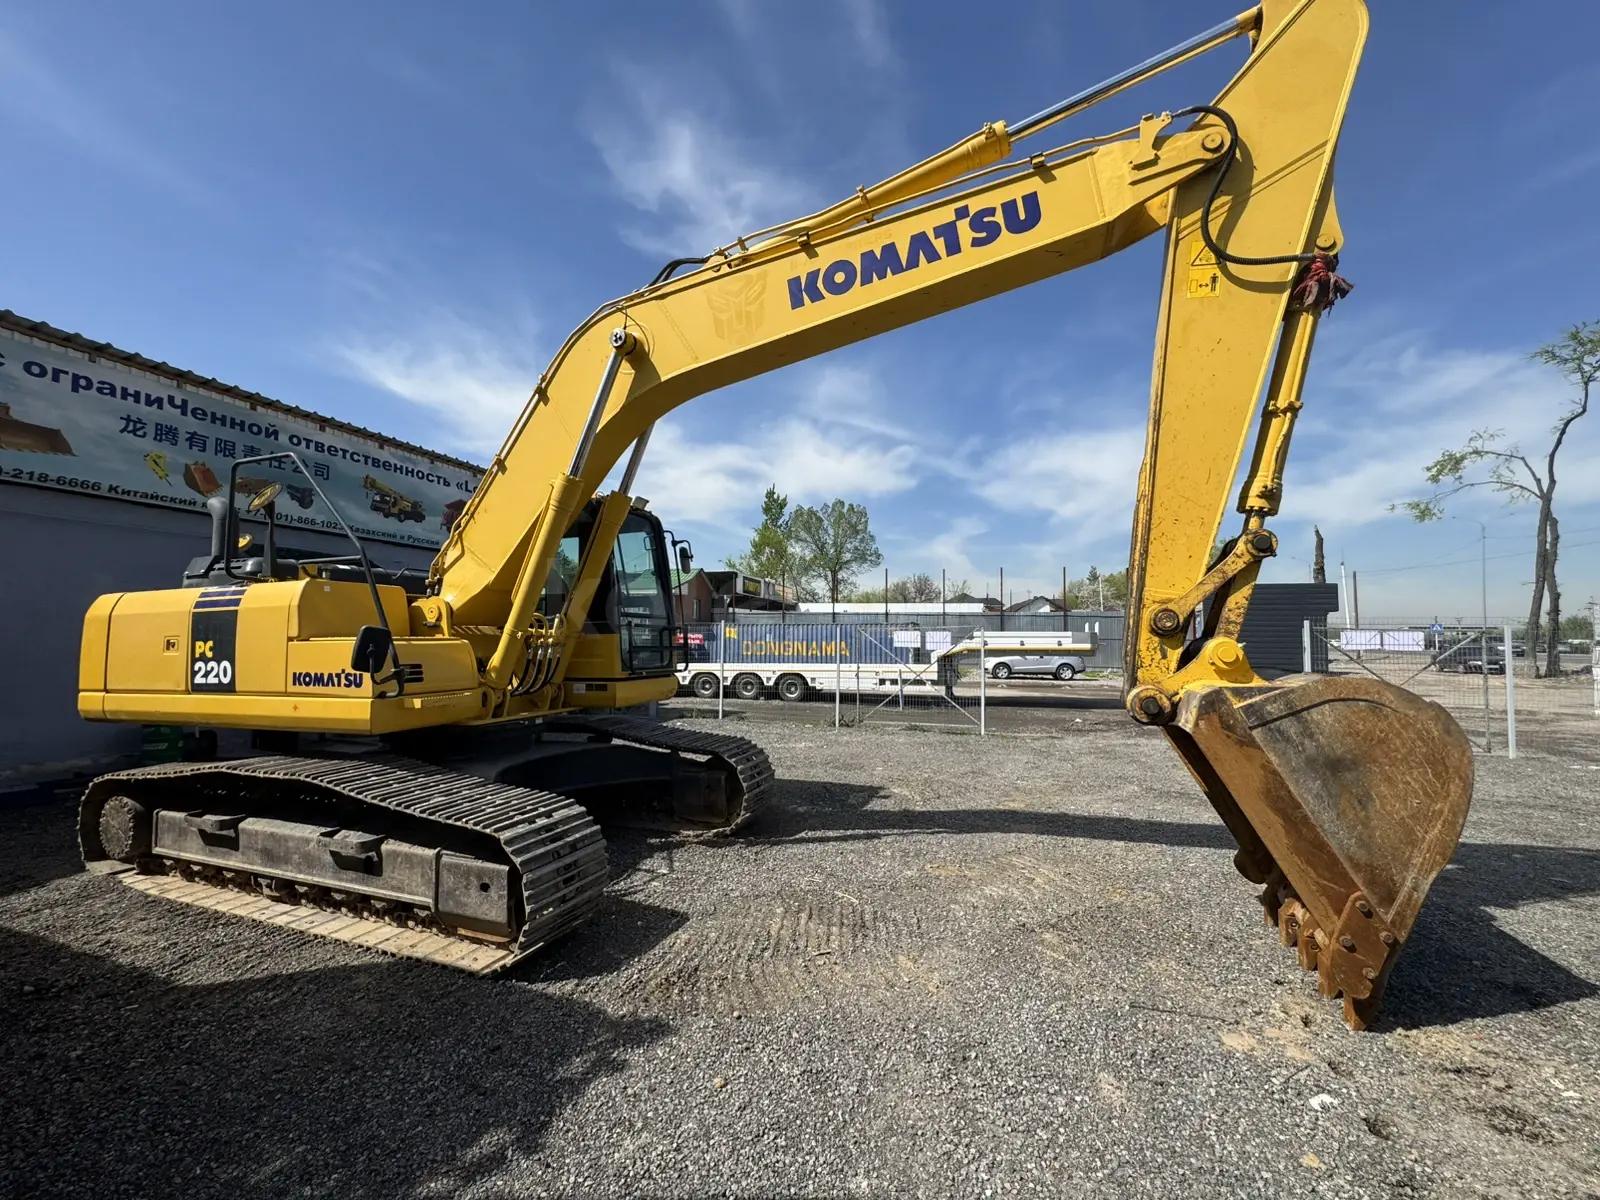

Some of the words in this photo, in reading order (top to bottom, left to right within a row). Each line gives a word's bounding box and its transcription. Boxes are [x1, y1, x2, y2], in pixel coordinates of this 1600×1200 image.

[787, 190, 1042, 311] KOMATSU
[288, 433, 451, 488] ответственность
[0, 465, 102, 491] -218-6666
[107, 482, 197, 507] Китайский
[195, 640, 213, 659] PC
[193, 660, 232, 684] 220
[292, 668, 363, 688] KOMATSU
